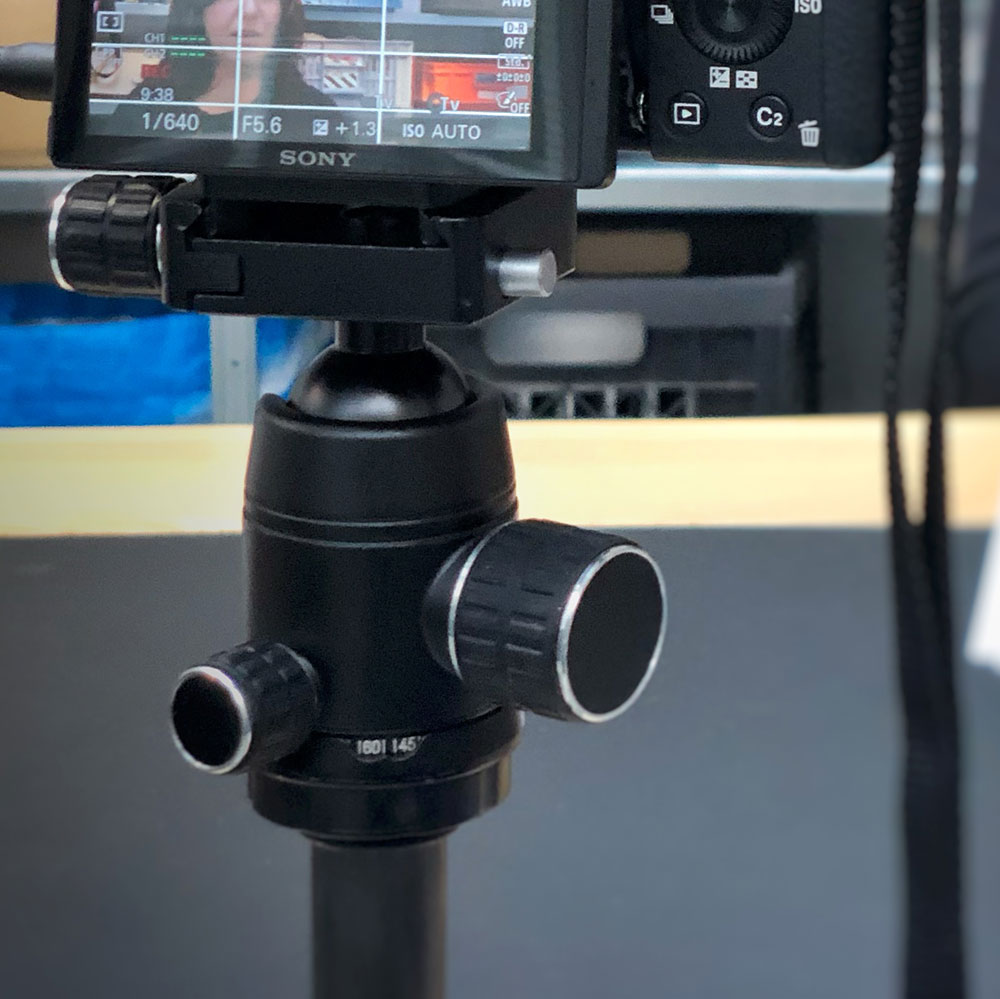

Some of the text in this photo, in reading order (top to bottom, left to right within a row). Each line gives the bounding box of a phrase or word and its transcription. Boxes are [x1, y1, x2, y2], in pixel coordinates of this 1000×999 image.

[504, 37, 526, 49] OFF
[140, 87, 174, 102] 9:38
[439, 96, 460, 111] Tv
[510, 102, 531, 114] OFF
[142, 112, 200, 131] 1/640
[242, 115, 283, 134] F5.6
[756, 107, 783, 126] C2
[402, 123, 482, 140] ISO AUTO
[279, 150, 357, 167] SONY
